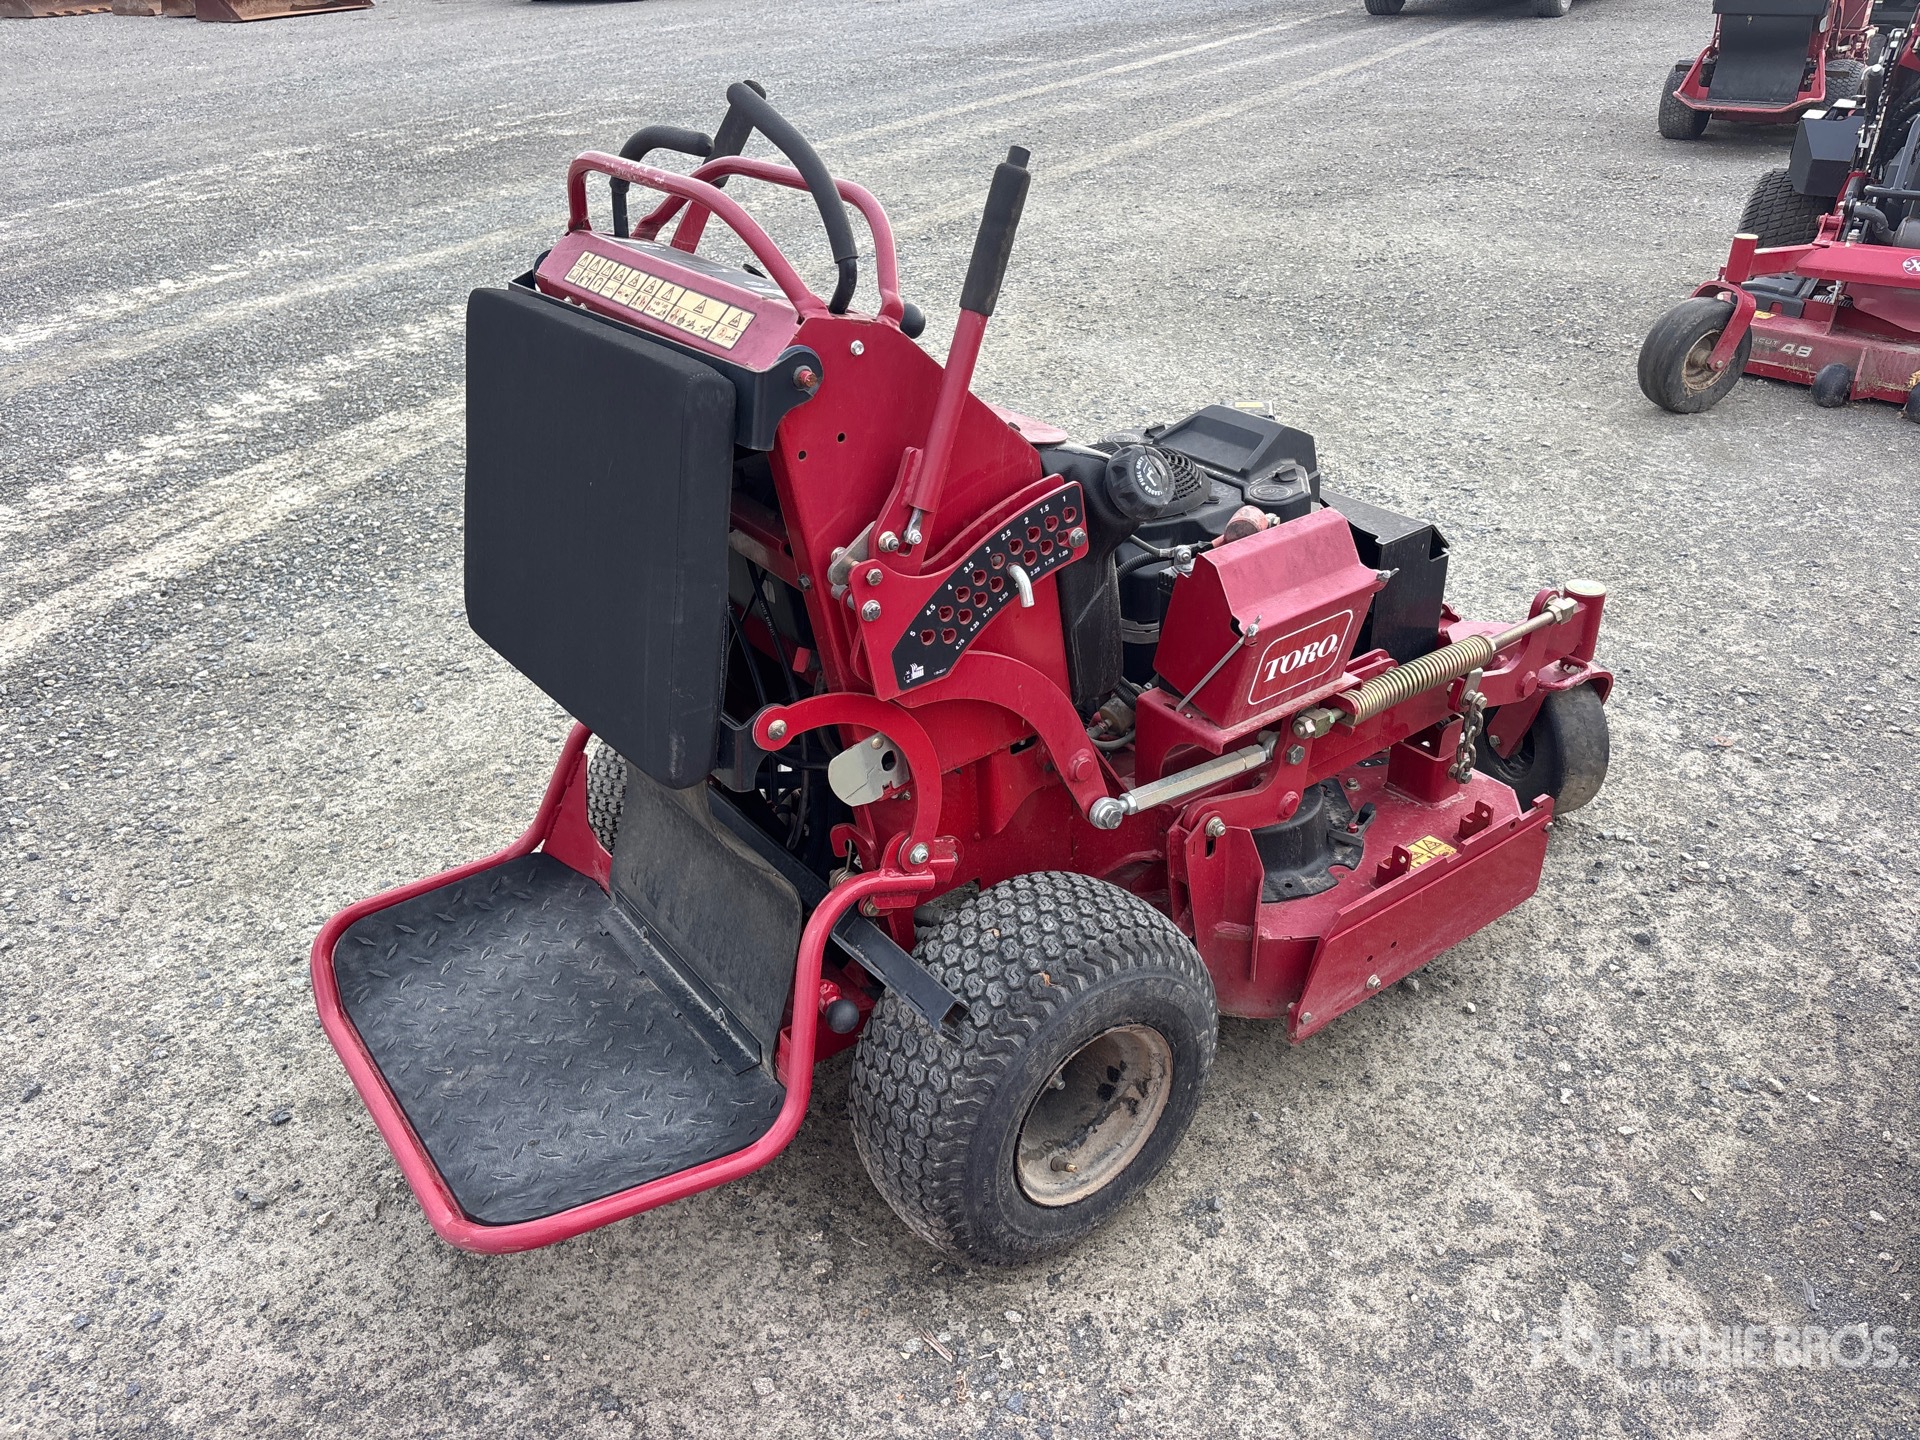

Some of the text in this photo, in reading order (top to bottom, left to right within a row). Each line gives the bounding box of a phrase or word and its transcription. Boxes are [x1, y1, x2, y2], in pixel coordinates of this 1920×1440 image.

[1780, 343, 1814, 358] 48
[926, 603, 936, 616] 4.5
[947, 583, 953, 591] 4
[963, 561, 975, 574] 3.5
[985, 546, 991, 554] 3
[1000, 529, 1012, 541] 2.5
[1023, 516, 1029, 525] 2
[1039, 503, 1050, 515] 1.5
[955, 638, 965, 650] 4.75
[982, 606, 993, 618] 3.75
[1030, 566, 1041, 577] 2.25
[1044, 556, 1055, 566] 1.75
[1263, 634, 1338, 683] TORO
